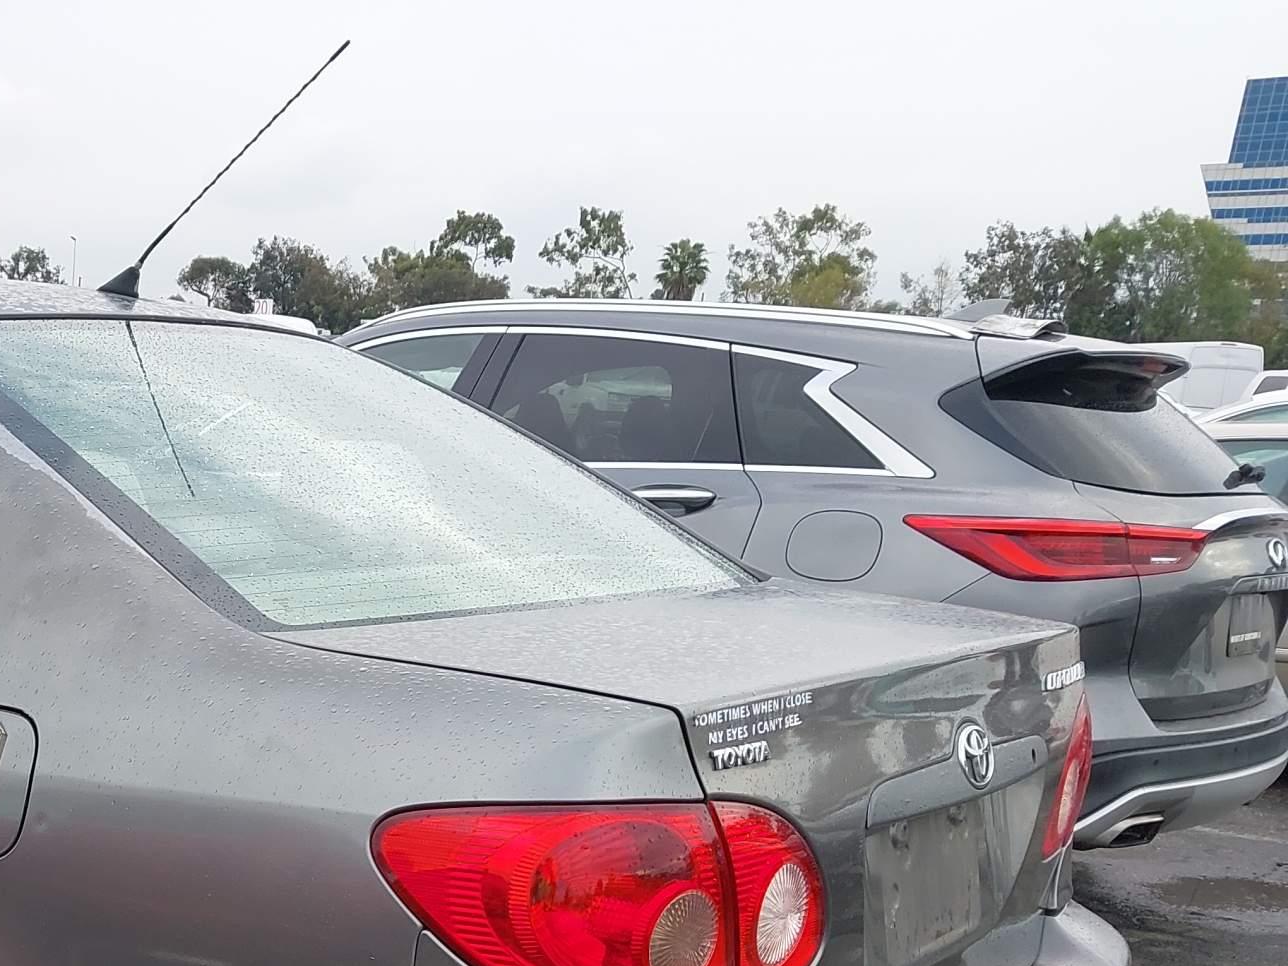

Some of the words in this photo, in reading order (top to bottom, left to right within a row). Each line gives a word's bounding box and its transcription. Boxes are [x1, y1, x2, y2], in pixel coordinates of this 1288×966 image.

[695, 704, 750, 726] SOMETIMES
[752, 699, 780, 715] WHEN
[785, 692, 813, 708] CLOSE
[708, 731, 724, 744] MY
[726, 725, 748, 741] EYES
[757, 717, 783, 735] CAN'T
[712, 741, 771, 769] TOYOTA
